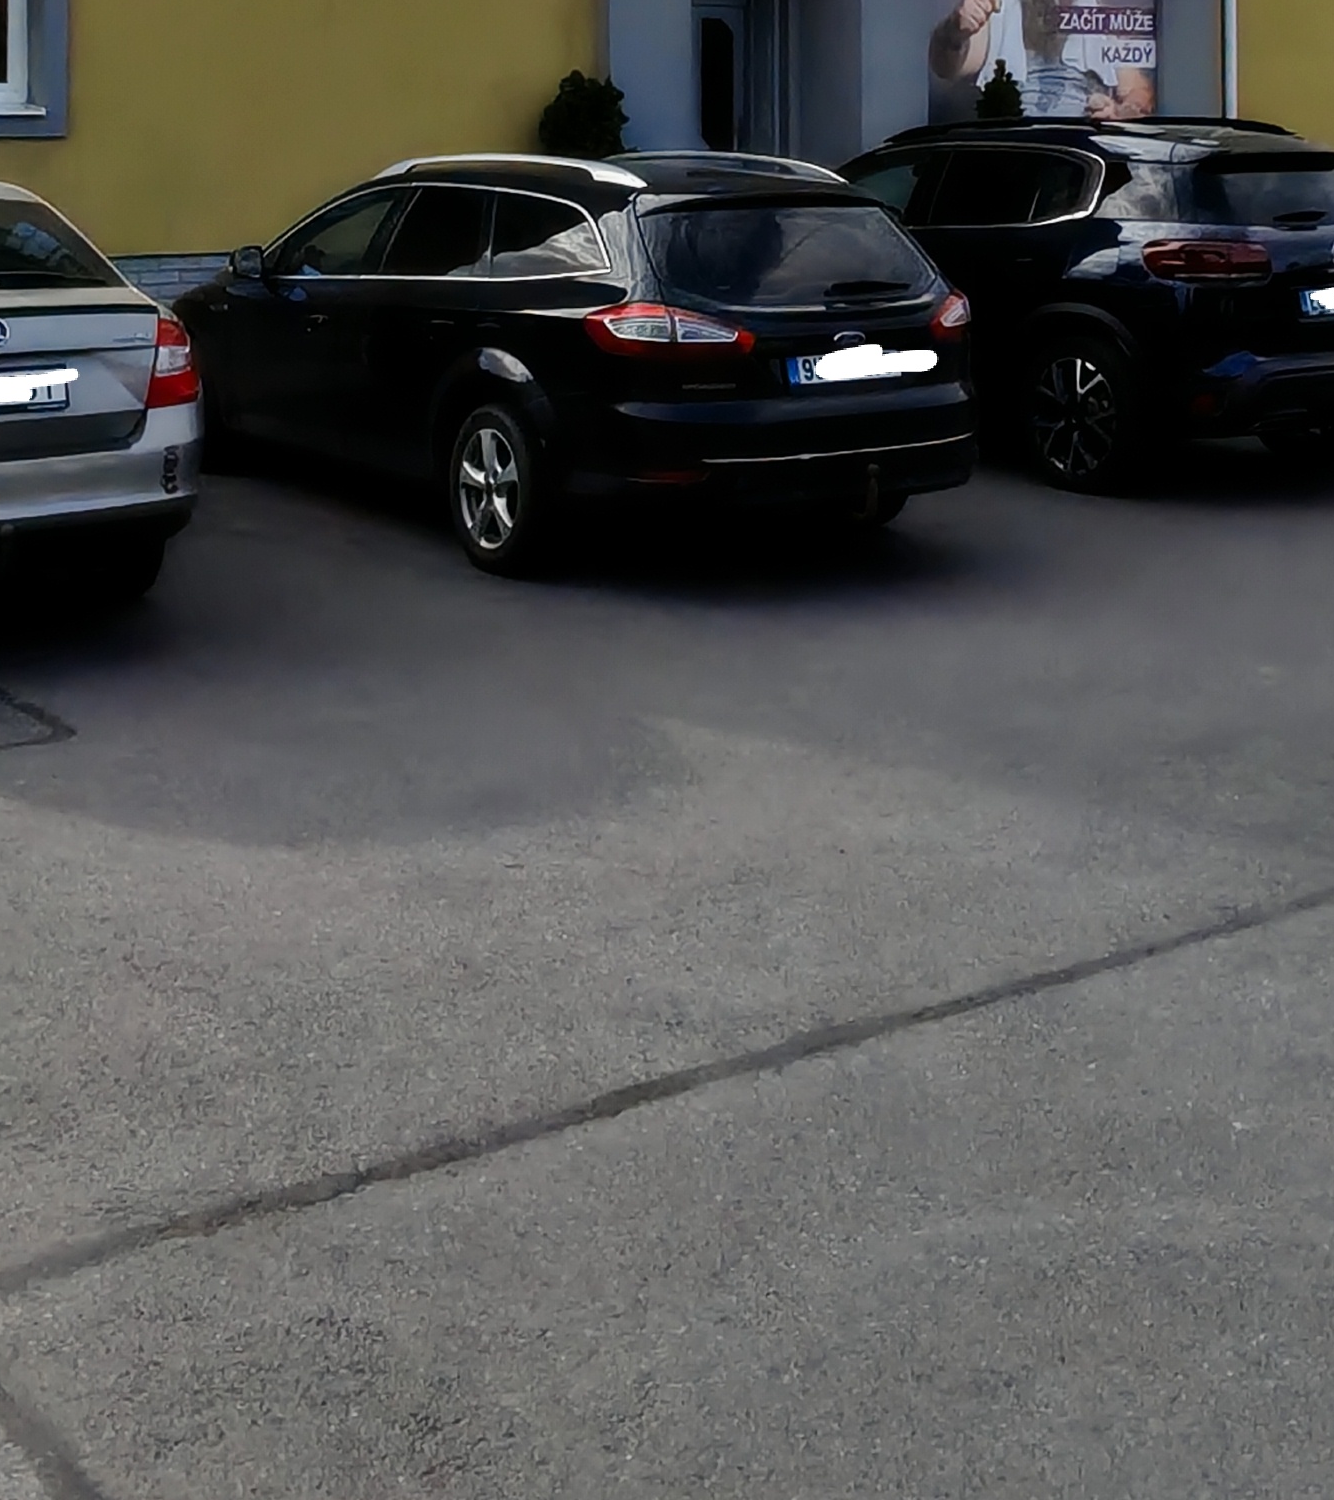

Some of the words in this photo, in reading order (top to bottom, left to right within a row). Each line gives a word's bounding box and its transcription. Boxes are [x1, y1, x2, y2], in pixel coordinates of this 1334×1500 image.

[1059, 8, 1106, 30] ZAČÍT
[1109, 9, 1154, 31] MŮŽE
[1101, 43, 1153, 63] KAŽDÝ
